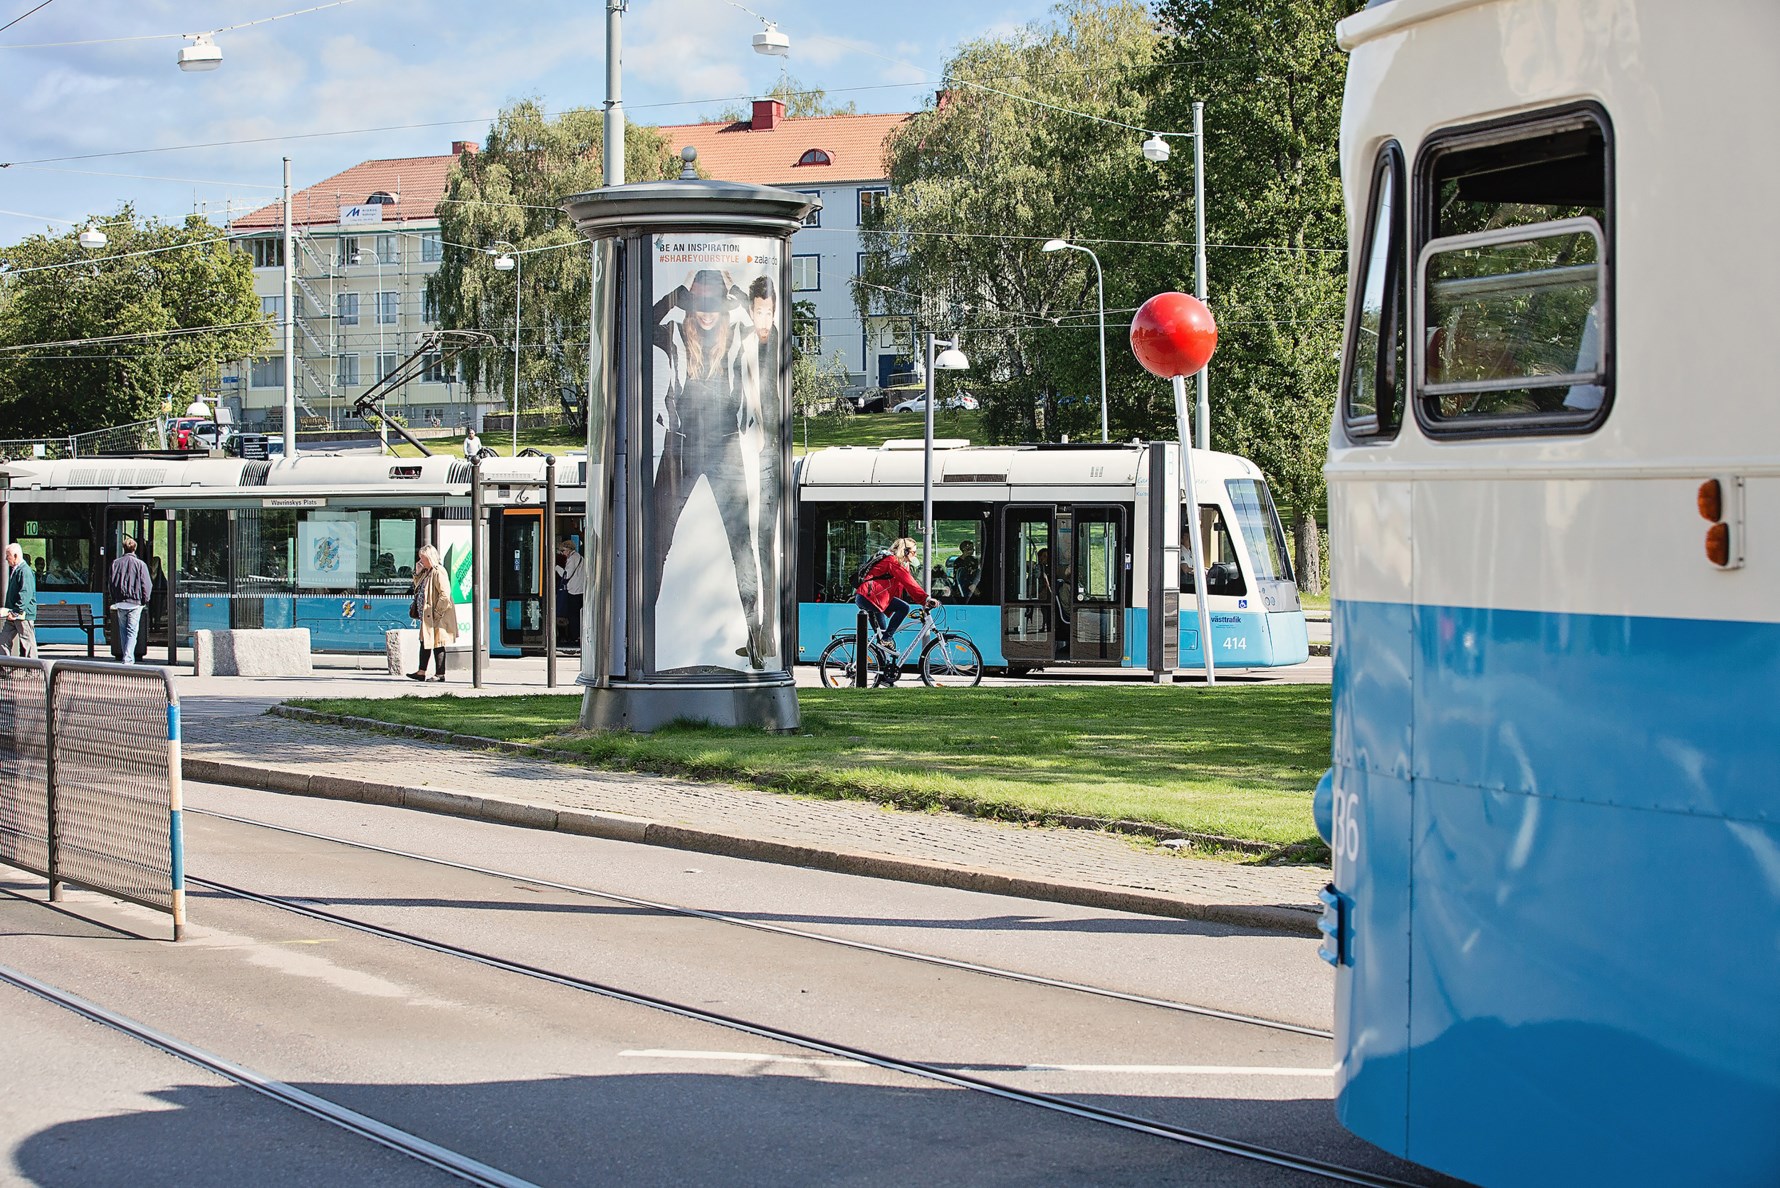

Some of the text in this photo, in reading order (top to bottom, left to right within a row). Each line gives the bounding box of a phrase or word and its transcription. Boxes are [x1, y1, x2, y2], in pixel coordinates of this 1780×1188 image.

[659, 243, 740, 252] BE AN INSPIRATION
[659, 254, 739, 263] #SHAREYOURSTYLE
[27, 522, 38, 535] 10
[1211, 616, 1241, 624] västtrafik
[1223, 637, 1247, 650] 414
